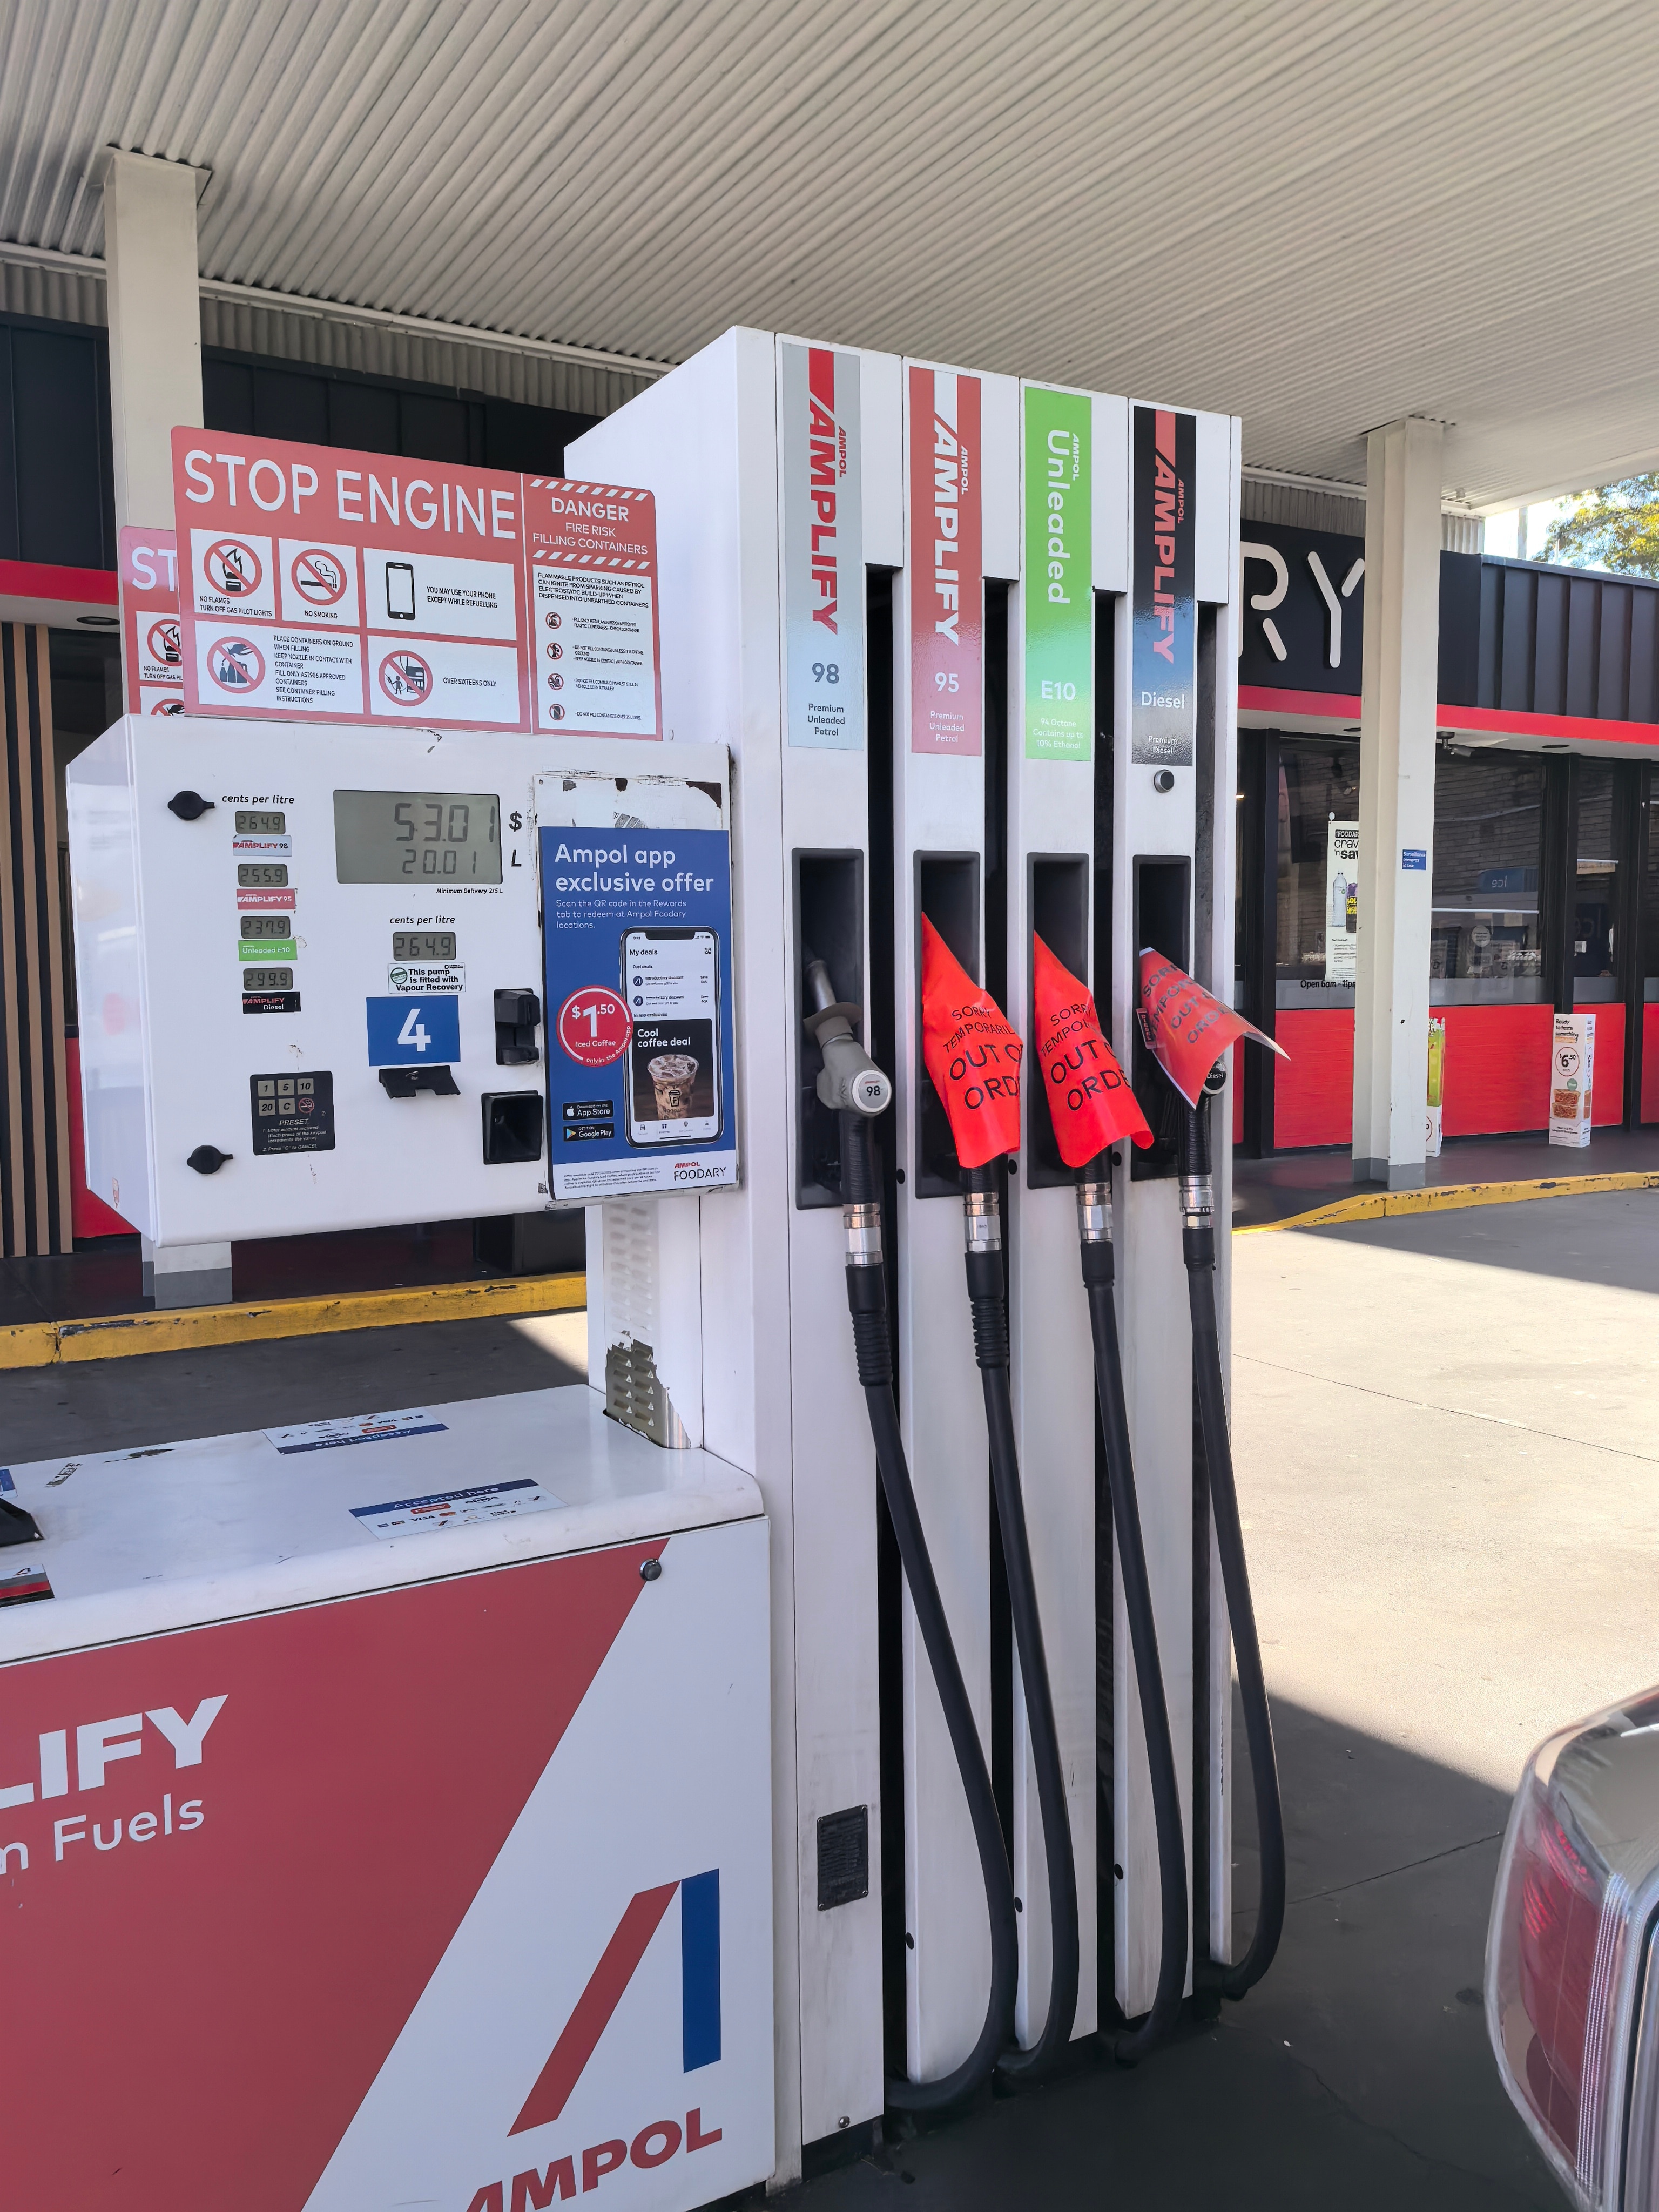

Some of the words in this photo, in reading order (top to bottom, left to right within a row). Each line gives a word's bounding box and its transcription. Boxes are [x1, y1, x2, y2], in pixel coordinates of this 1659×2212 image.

[839, 426, 847, 478] AMPOL
[185, 450, 318, 514] STOP
[336, 469, 516, 539] ENGINE
[551, 497, 629, 522] DANGER
[809, 397, 838, 635] AMPLIFY
[1047, 429, 1070, 604] Unleaded
[565, 522, 589, 534] FIRE
[592, 525, 616, 537] RISK
[934, 417, 959, 646] AMPLIFY
[533, 533, 575, 547] FILLING
[578, 538, 648, 555] CONTAINERS
[1154, 454, 1176, 664] AMPLIFY
[428, 596, 447, 604] EXCEPT
[466, 599, 497, 609] REFUELLING
[478, 591, 496, 599] PHONE
[812, 663, 840, 684] 98
[935, 672, 959, 692] 95
[1041, 680, 1076, 701] E10
[808, 703, 844, 713] Premium
[1141, 691, 1185, 710] Diesel
[807, 715, 845, 725] Unleaded
[930, 711, 963, 720] Premium
[1051, 719, 1076, 727] Octane
[814, 726, 839, 737] Petrol
[929, 722, 965, 732] Unleaded
[1033, 729, 1064, 737] Contains
[935, 733, 958, 743] Petrol
[1148, 735, 1177, 746] Premium
[1152, 746, 1172, 754] Diesel
[252, 796, 269, 805] per
[273, 795, 294, 804] litre
[238, 815, 280, 831] 264.9
[394, 802, 496, 843] 53.01
[508, 811, 522, 832] $
[402, 849, 477, 874] 20.01
[511, 850, 522, 867] L
[555, 844, 628, 868] Ampol
[635, 849, 676, 868] app
[241, 868, 283, 882] 255.9
[555, 872, 655, 891] exclusive
[662, 872, 714, 892] offer
[594, 899, 606, 907] QR
[244, 920, 285, 934] 237.9
[395, 936, 451, 956] 264.9
[246, 972, 288, 986] 299.9
[1300, 980, 1319, 989] Open
[952, 1006, 991, 1021] SORRY
[1171, 996, 1199, 1029] OUT
[396, 1008, 431, 1052] 4
[637, 1028, 658, 1037] Cool
[638, 1038, 668, 1048] coffee
[670, 1036, 690, 1046] deal
[950, 1044, 1000, 1081] OUT
[1051, 1040, 1098, 1084] OUT
[866, 1085, 881, 1097] 98
[965, 1076, 1020, 1110] ORD
[674, 1166, 726, 1181] FOODARY
[394, 1493, 463, 1509] Accepted
[466, 1487, 499, 1496] here
[54, 1793, 205, 1862] Fuels
[466, 2107, 723, 2212] AMPOL
